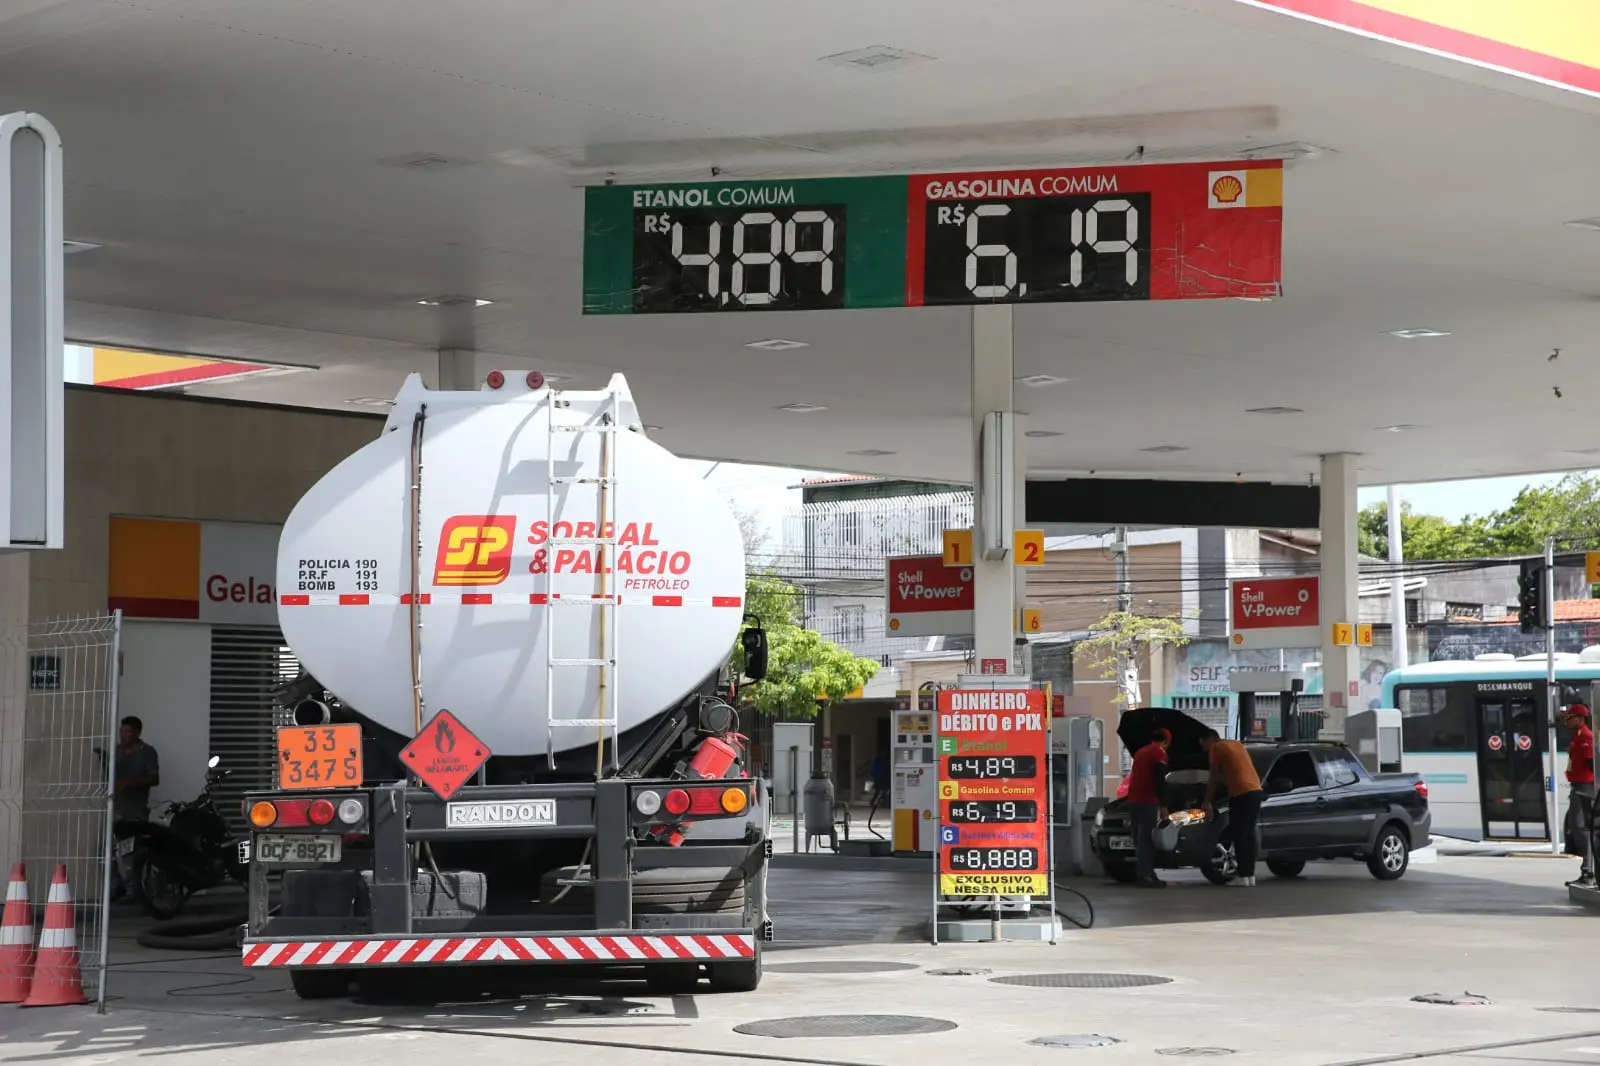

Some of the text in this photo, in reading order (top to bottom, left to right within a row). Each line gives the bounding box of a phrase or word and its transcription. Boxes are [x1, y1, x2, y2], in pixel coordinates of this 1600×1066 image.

[926, 175, 1118, 199] GASOLINA COMUM
[633, 187, 795, 207] ETANOL COMUM
[937, 199, 1138, 297] R$ 6,19
[644, 210, 834, 306] R$ 4,89
[529, 545, 691, 574] & PALÁCIO
[951, 543, 960, 562] 1
[1023, 542, 1039, 562] 2
[299, 559, 378, 569] POLICIA 190
[299, 570, 378, 580] P.R.F 191
[898, 571, 923, 584] Shell
[206, 574, 277, 604] Gela
[299, 581, 378, 590] BOMB 193
[625, 576, 689, 590] PETRÓLEO
[899, 585, 964, 600] V-Power
[1240, 591, 1264, 603] Shell
[1243, 604, 1301, 617] V-Power
[1031, 616, 1039, 630] 6
[1340, 630, 1348, 641] 7
[1364, 631, 1371, 642] 8
[1190, 666, 1223, 681] SELF
[951, 692, 1030, 711] DINHEIRO,
[941, 711, 1042, 731] DÉBITO e PIX
[303, 729, 336, 753] 33
[942, 740, 951, 752] E
[289, 758, 357, 784] 3475
[951, 757, 1015, 778] R$ 4,89
[943, 785, 1035, 797] G Gasolina Comum
[451, 803, 551, 824] RANDON
[952, 801, 1016, 822] R$ 6,19
[943, 829, 953, 841] G
[953, 849, 1033, 870] R$ 8,888
[956, 875, 1032, 884] EXCLUSIVO
[954, 885, 1035, 894] NESSA ILHA
